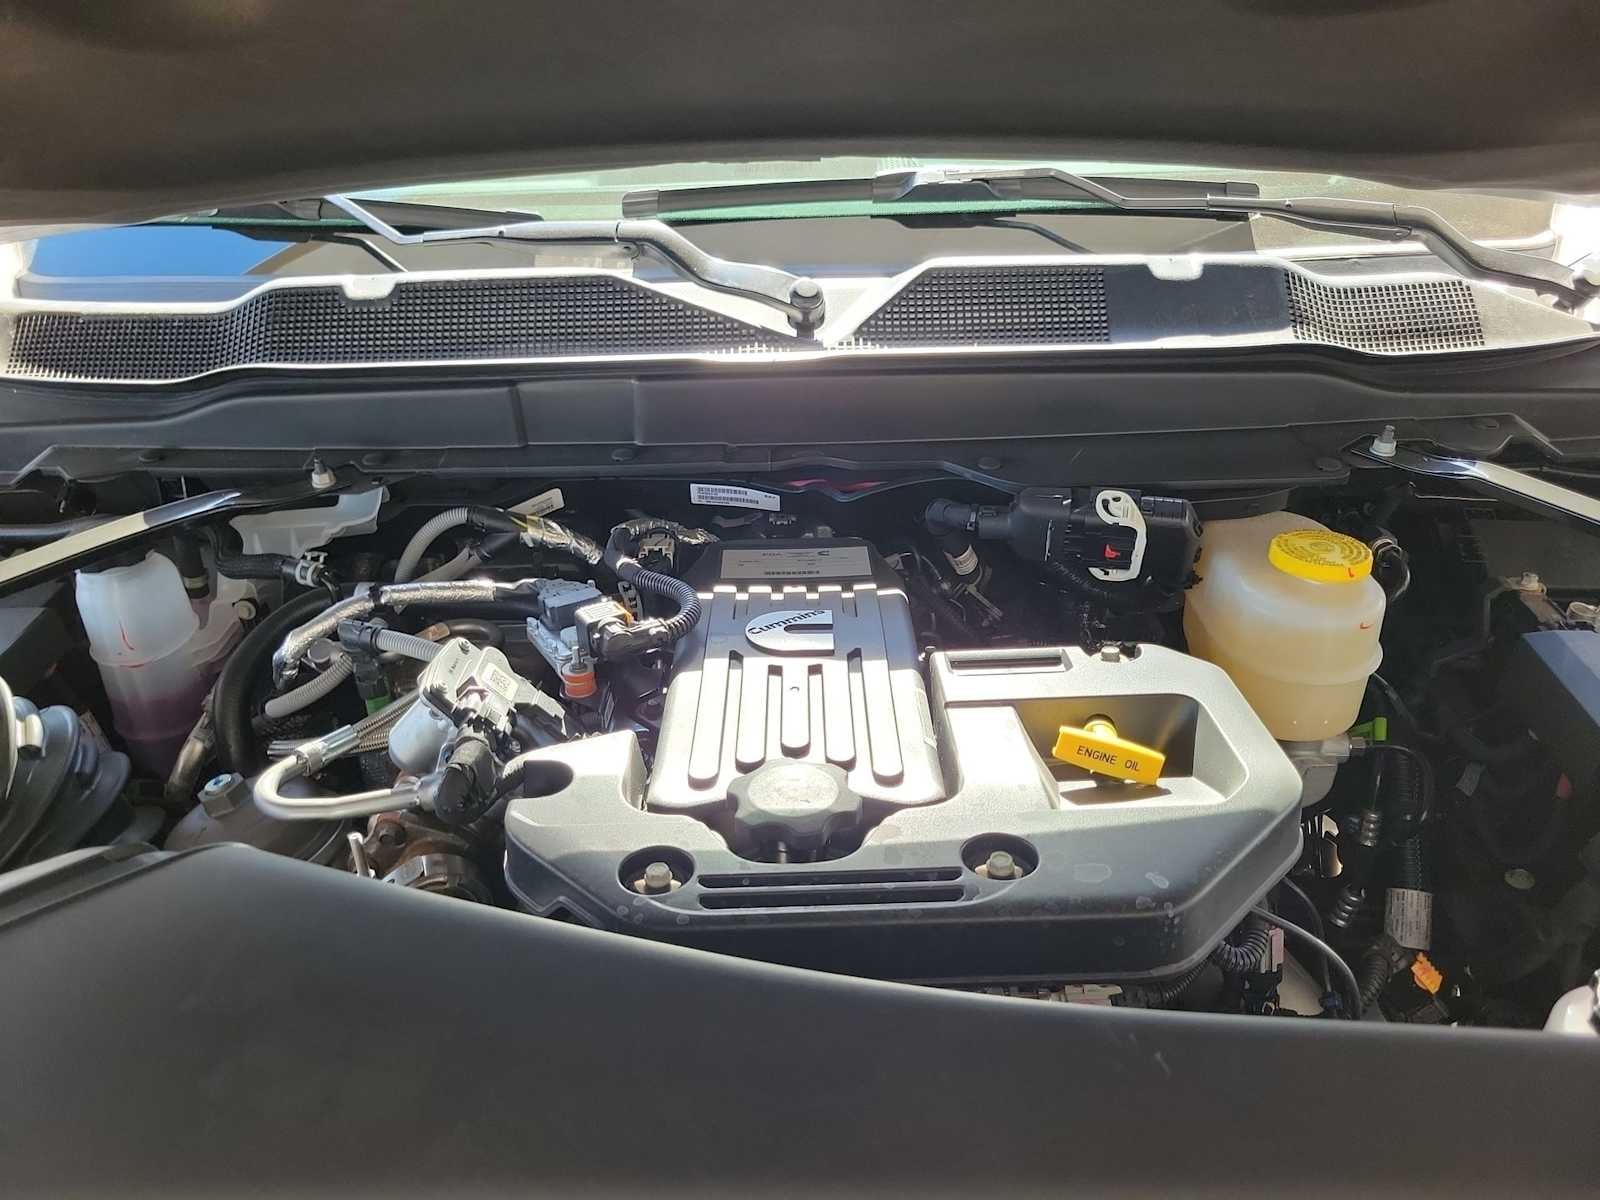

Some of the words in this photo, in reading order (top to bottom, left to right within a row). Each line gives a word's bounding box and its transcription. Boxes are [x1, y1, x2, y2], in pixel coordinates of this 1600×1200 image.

[748, 609, 826, 635] Cummins
[1076, 745, 1118, 765] ENGINE
[1124, 759, 1140, 772] OIL
